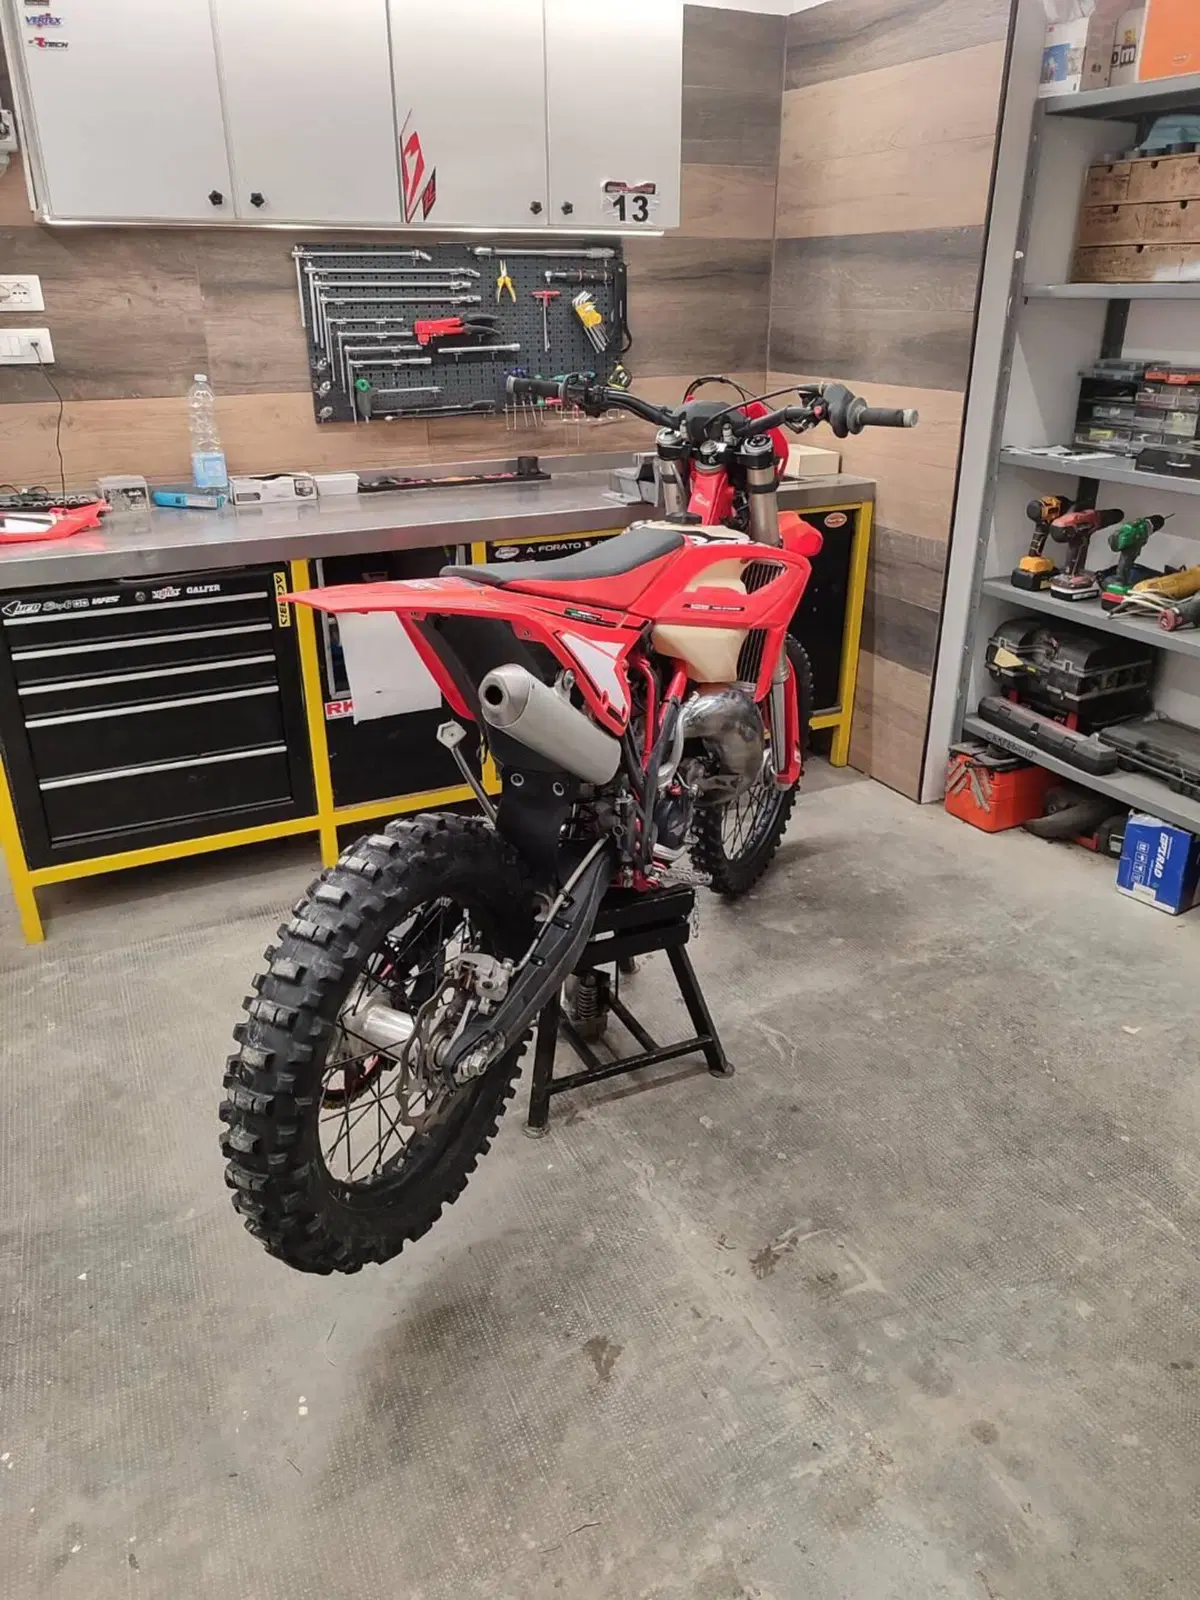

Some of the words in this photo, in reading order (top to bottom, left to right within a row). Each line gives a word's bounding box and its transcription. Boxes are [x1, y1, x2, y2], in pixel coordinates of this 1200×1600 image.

[612, 194, 649, 222] 13
[538, 542, 582, 553] FORATO
[186, 584, 221, 595] GALFER
